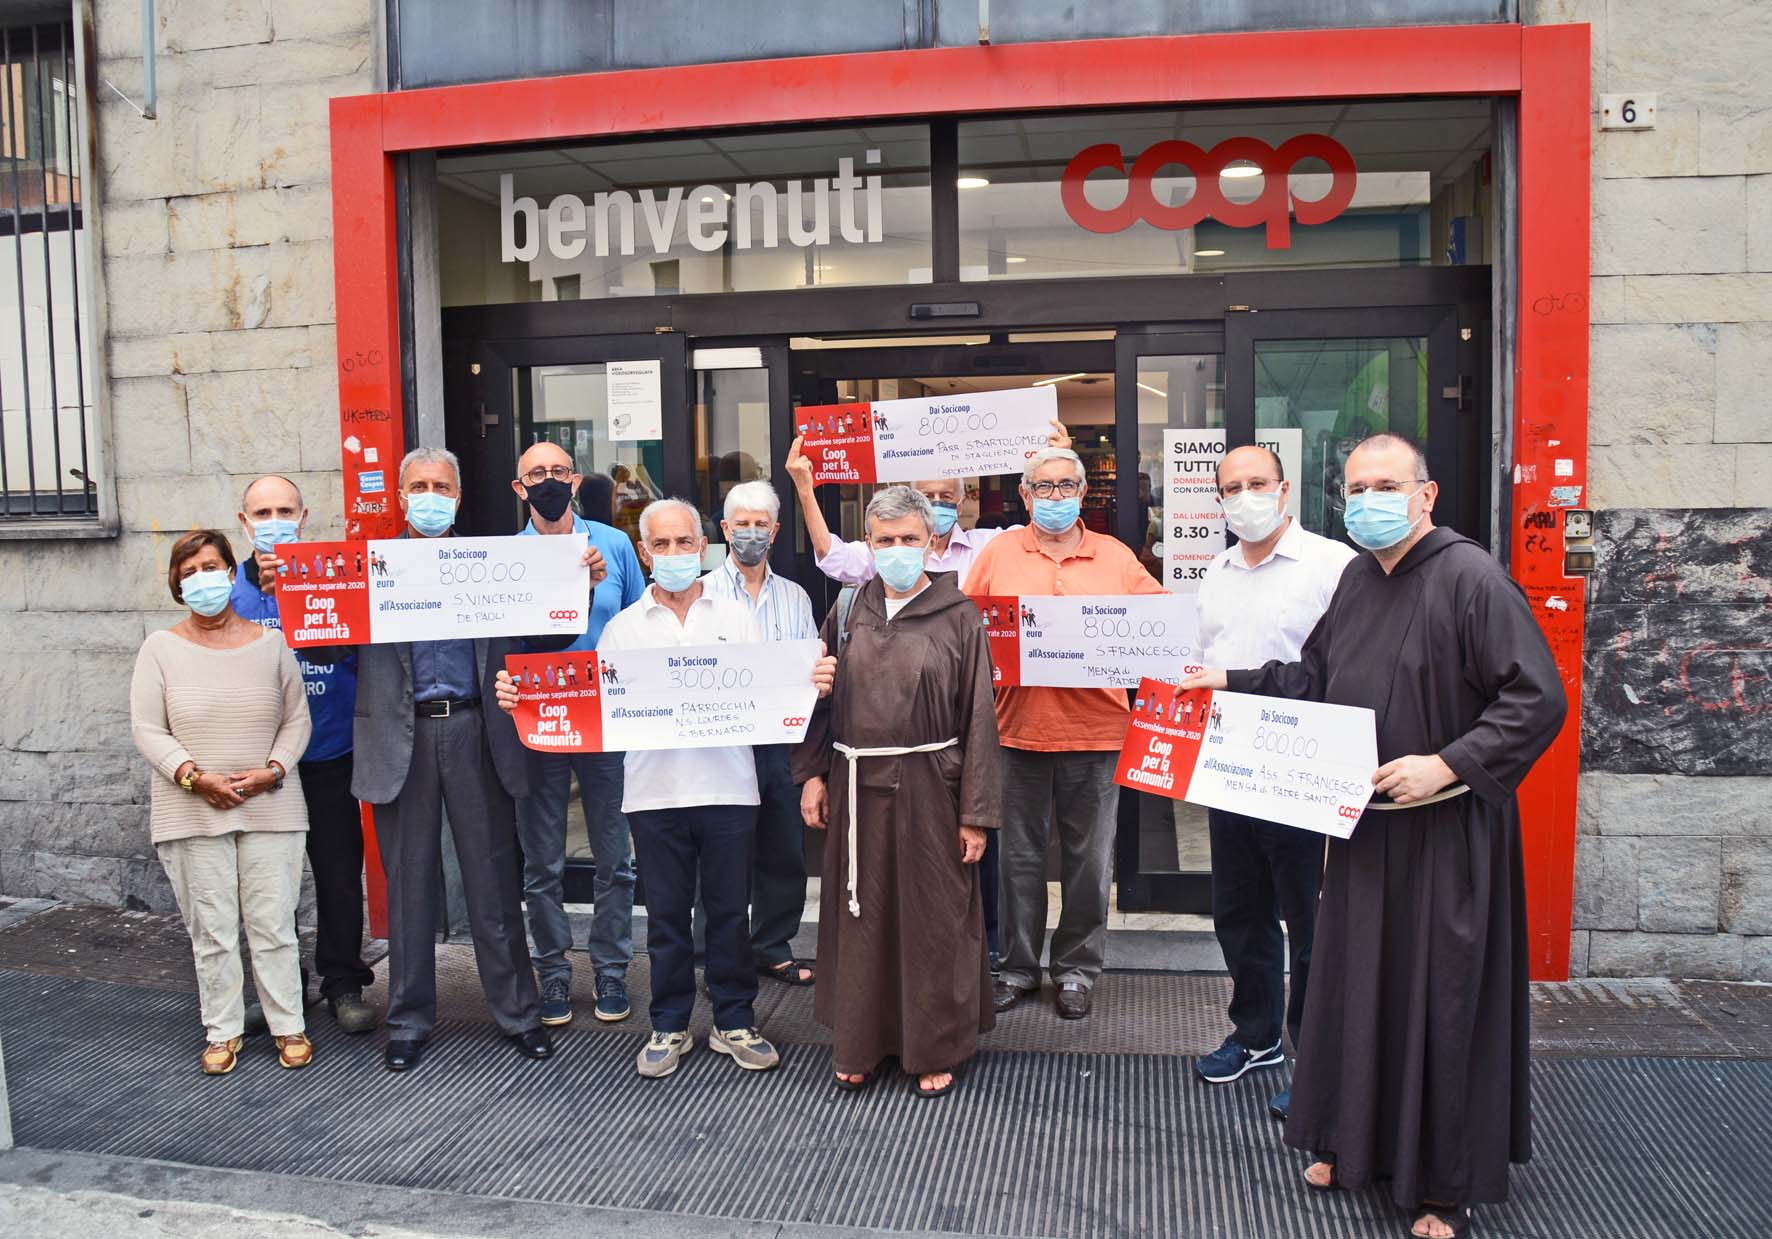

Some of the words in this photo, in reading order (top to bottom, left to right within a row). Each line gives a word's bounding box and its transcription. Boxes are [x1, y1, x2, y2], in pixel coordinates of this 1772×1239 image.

[1622, 100, 1636, 123] 6
[1061, 133, 1357, 248] coop
[501, 149, 882, 263] benvenuti
[929, 406, 940, 415] Dai
[941, 404, 970, 414] Socicoop
[803, 438, 832, 447] Assemblee
[832, 437, 855, 446] separate
[855, 435, 871, 443] 2020
[879, 433, 894, 441] euro
[882, 447, 934, 459] all'Associazione
[1174, 442, 1225, 454] SIAMO
[822, 448, 846, 462] Coop
[822, 461, 838, 472] per
[840, 459, 849, 470] la
[1174, 461, 1217, 472] TUTTI
[815, 468, 860, 480] comunità
[1173, 527, 1208, 538] 8.30
[438, 550, 451, 560] Dai
[452, 548, 487, 561] Socicoop
[282, 583, 318, 592] Assemblee
[319, 582, 347, 591] separate
[348, 581, 366, 589] 2020
[376, 580, 395, 588] euro
[305, 595, 335, 611] Coop
[379, 600, 442, 612] all'Associazione
[549, 610, 578, 621] coop
[1082, 606, 1094, 615] Dai
[1095, 606, 1127, 617] Socicoop
[304, 613, 325, 629] per
[327, 609, 338, 624] la
[457, 613, 471, 624] DE
[294, 623, 350, 641] comunità
[1026, 630, 1042, 638] euro
[1028, 649, 1084, 659] all'Associazione
[668, 657, 681, 667] Dai
[682, 656, 718, 668] Socicoop
[551, 690, 578, 699] separate
[579, 689, 597, 697] 2020
[607, 687, 626, 696] euro
[539, 703, 567, 719] Coop
[611, 706, 673, 719] all'Associazione
[681, 700, 756, 714] PARROCCHIA
[783, 717, 807, 726] coo
[1260, 709, 1272, 721] Dai
[1271, 710, 1298, 728] Socicoop
[538, 720, 556, 734] per
[560, 716, 570, 731] la
[1132, 718, 1165, 734] Assemblee
[1165, 727, 1187, 738] separate
[1186, 730, 1202, 741] 2020
[528, 731, 582, 746] comunità
[1208, 734, 1224, 744] euro
[1149, 736, 1173, 756] Coop
[1141, 754, 1160, 771] per
[1160, 753, 1170, 772] la
[1126, 767, 1174, 790] comunità
